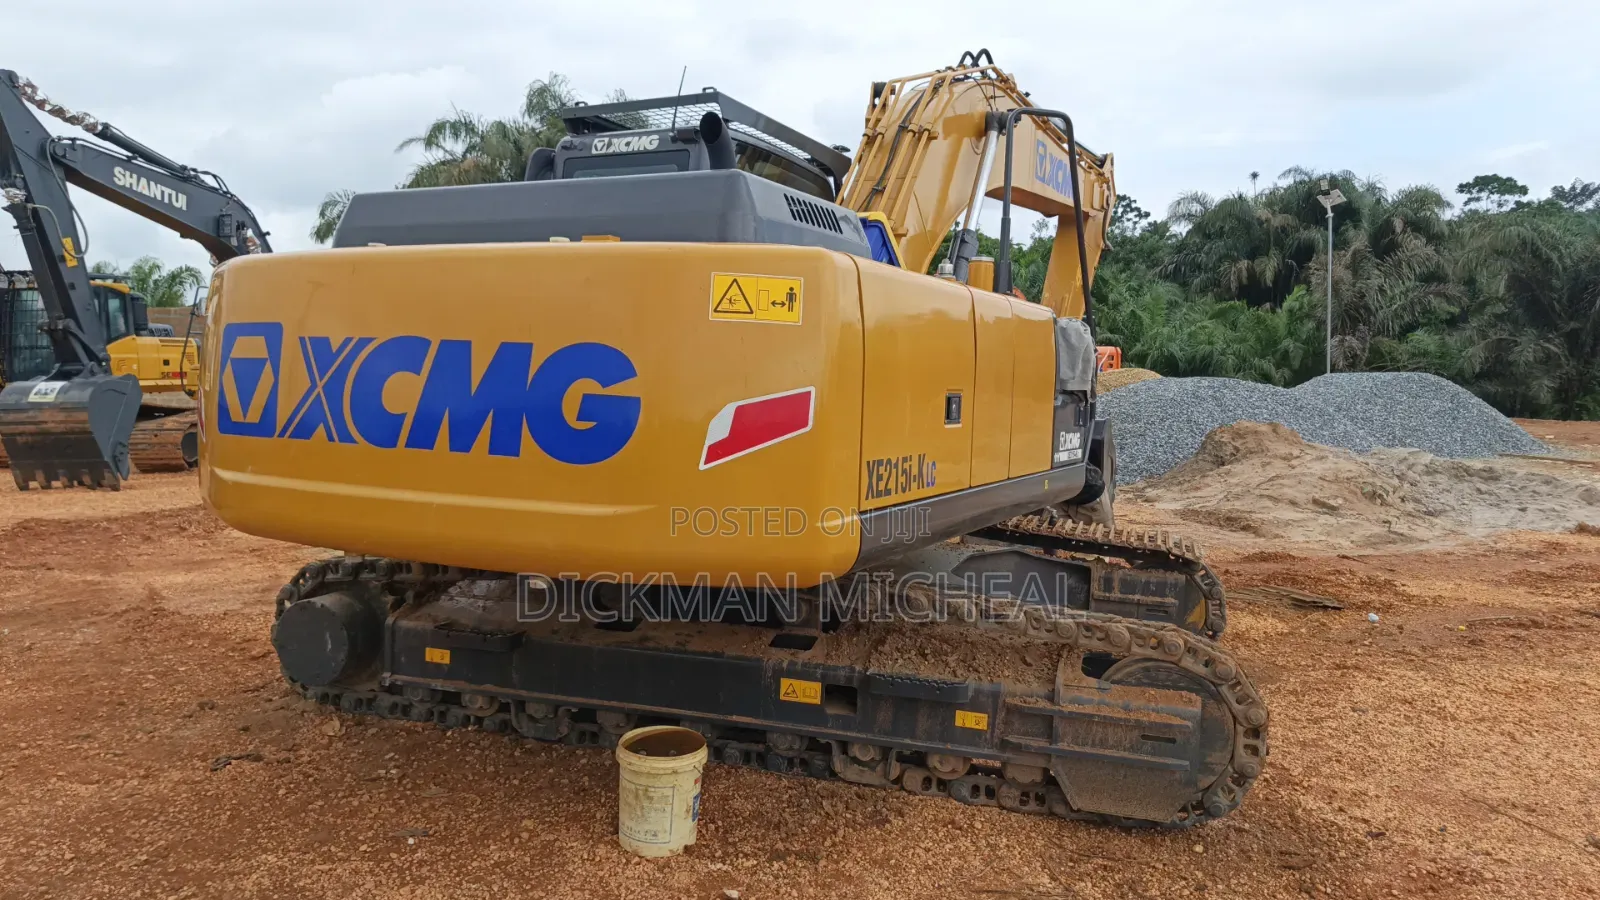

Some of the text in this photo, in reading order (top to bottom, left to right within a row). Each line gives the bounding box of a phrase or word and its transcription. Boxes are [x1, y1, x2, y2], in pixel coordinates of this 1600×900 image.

[606, 134, 660, 153] XCMG
[113, 166, 187, 211] SHANTUI
[1045, 152, 1074, 201] XCM
[277, 335, 642, 465] XCMG
